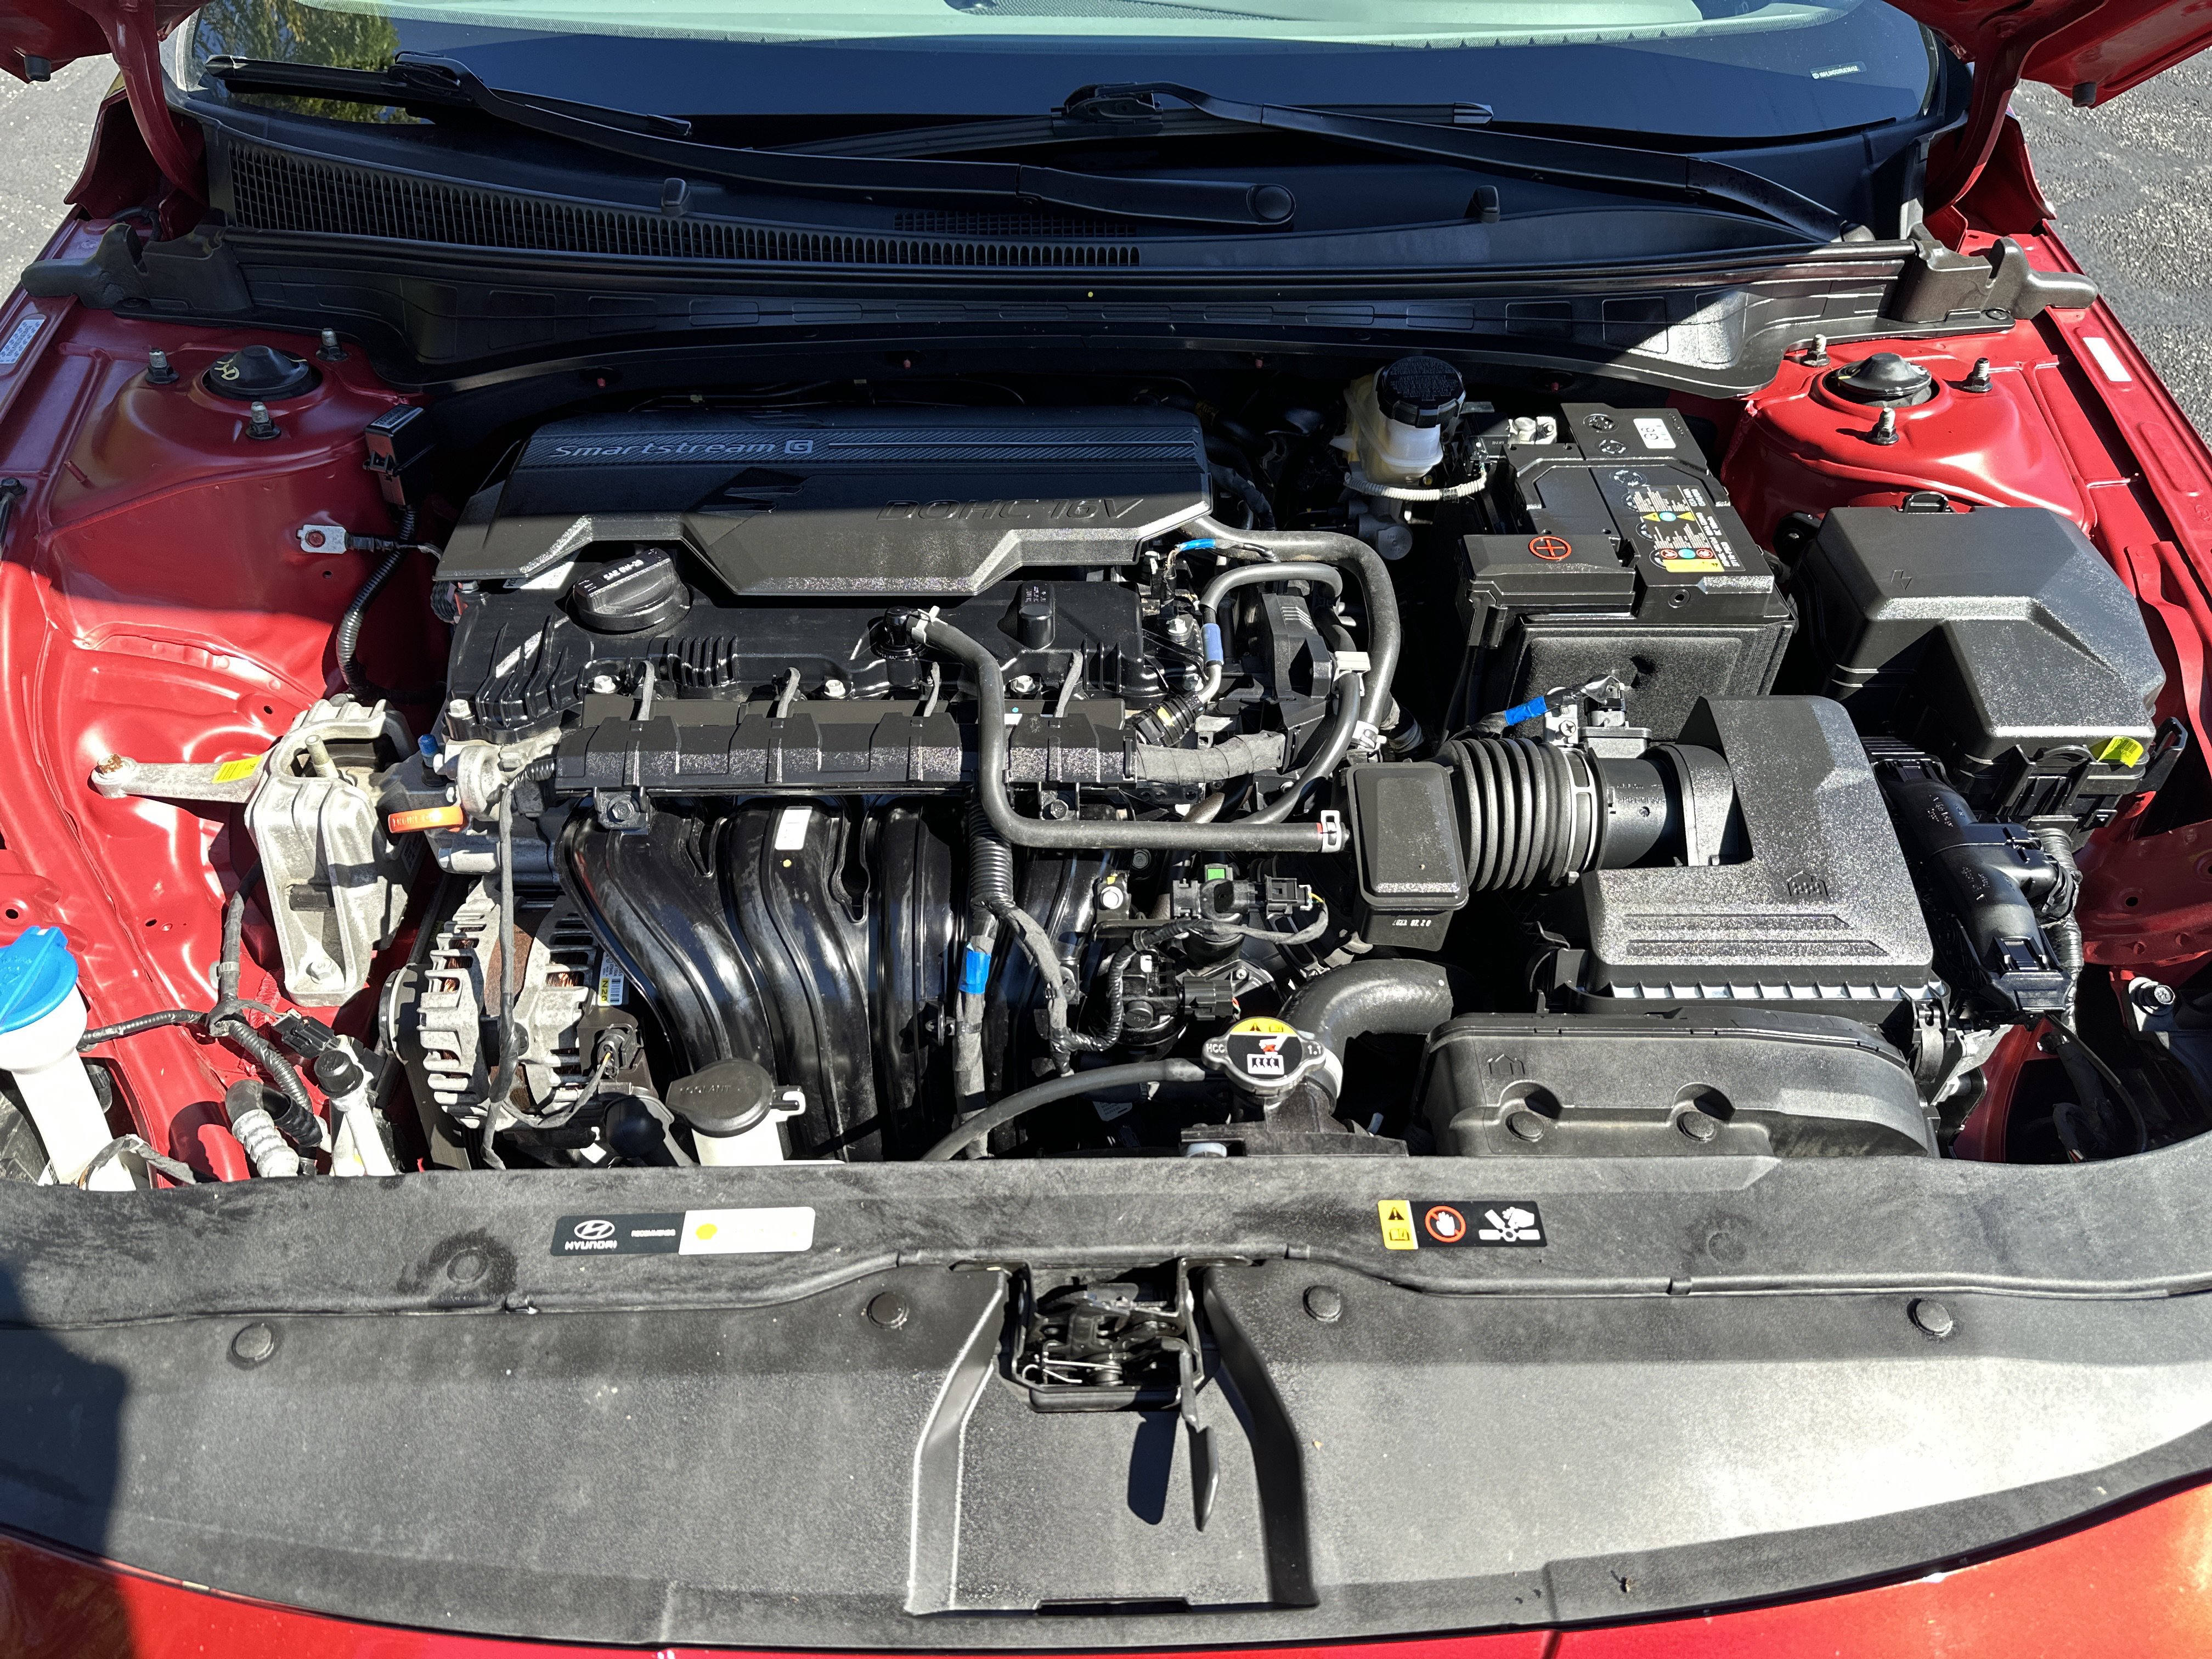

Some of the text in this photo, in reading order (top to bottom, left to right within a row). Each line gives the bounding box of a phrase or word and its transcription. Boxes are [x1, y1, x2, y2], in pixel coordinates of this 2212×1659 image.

[549, 442, 776, 458] Smartstream
[877, 498, 1144, 521] DOHC 16V
[603, 559, 645, 580] SAE 0W-20
[1206, 1043, 1226, 1053] HCC
[1307, 1045, 1321, 1054] 1.1
[565, 1240, 618, 1251] HYUNDAI
